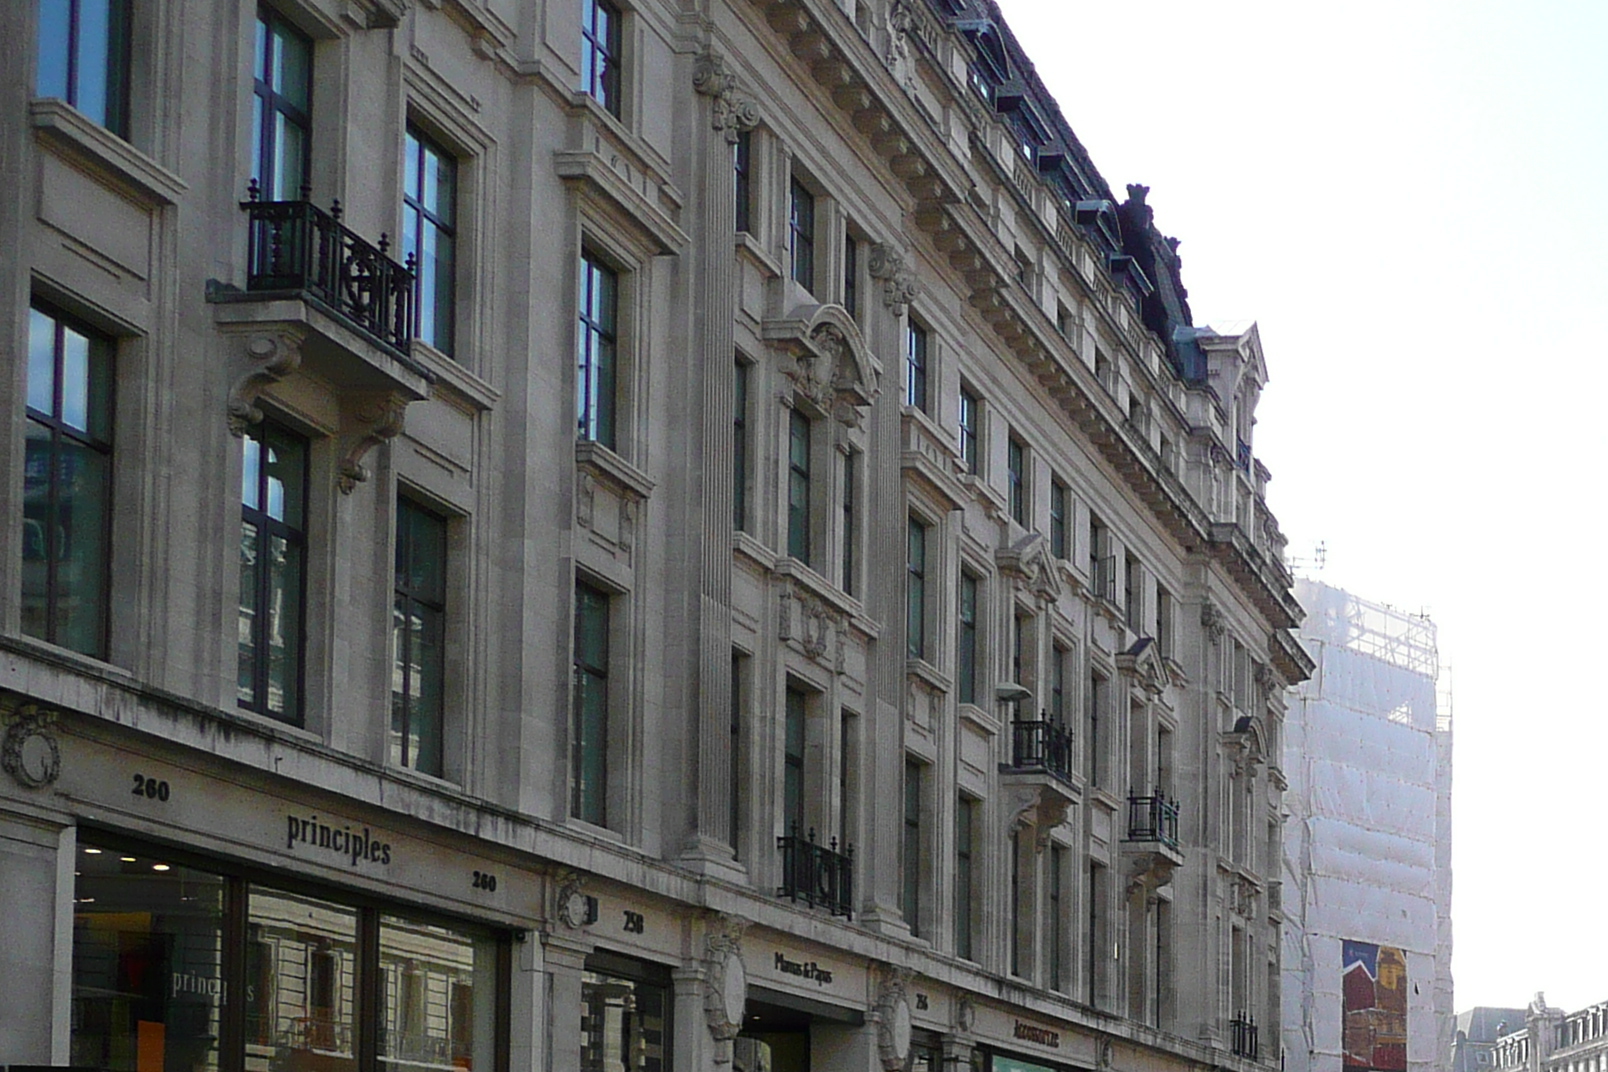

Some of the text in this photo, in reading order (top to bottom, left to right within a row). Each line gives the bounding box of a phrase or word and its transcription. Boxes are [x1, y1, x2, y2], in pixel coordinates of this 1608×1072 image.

[132, 774, 170, 802] 260
[287, 814, 391, 866] principles
[472, 870, 497, 893] 260
